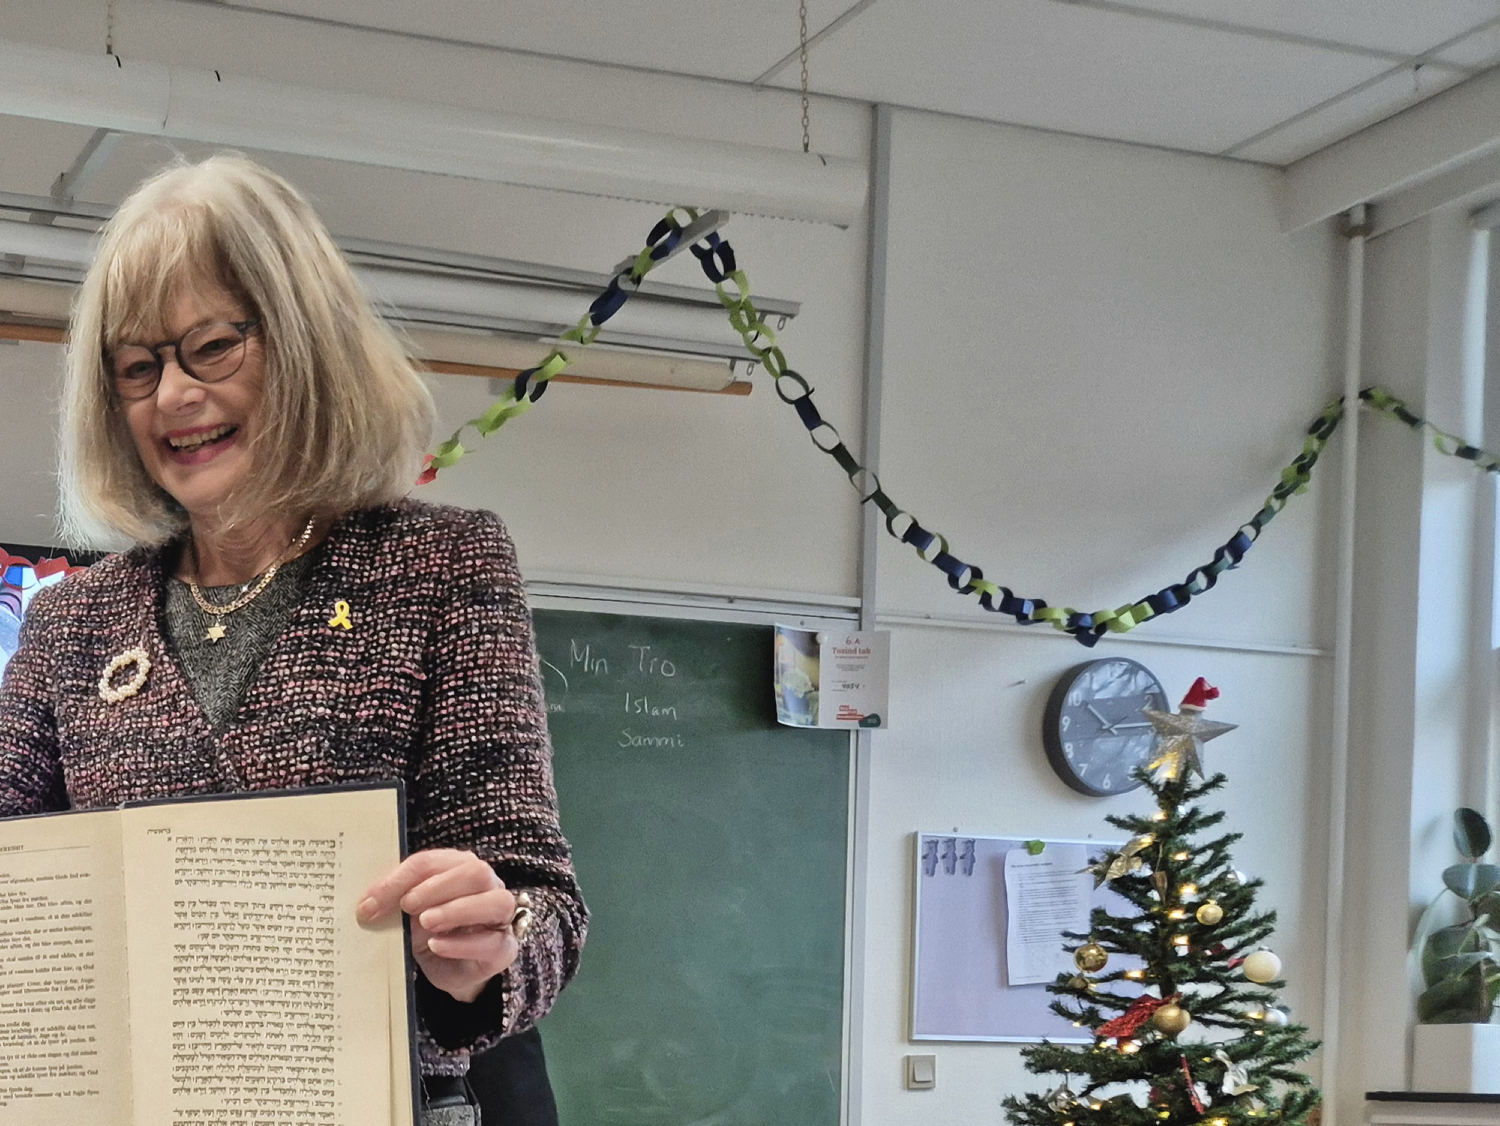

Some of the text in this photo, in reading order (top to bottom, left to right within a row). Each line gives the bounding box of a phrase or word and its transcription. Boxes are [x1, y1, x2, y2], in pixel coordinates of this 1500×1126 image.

[570, 639, 676, 677] Min Tro
[625, 692, 677, 720] Islam
[1068, 690, 1082, 707] 10
[1062, 715, 1071, 732] 9
[1063, 742, 1074, 759] 8
[1078, 763, 1088, 777] 7
[1102, 774, 1111, 789] 6
